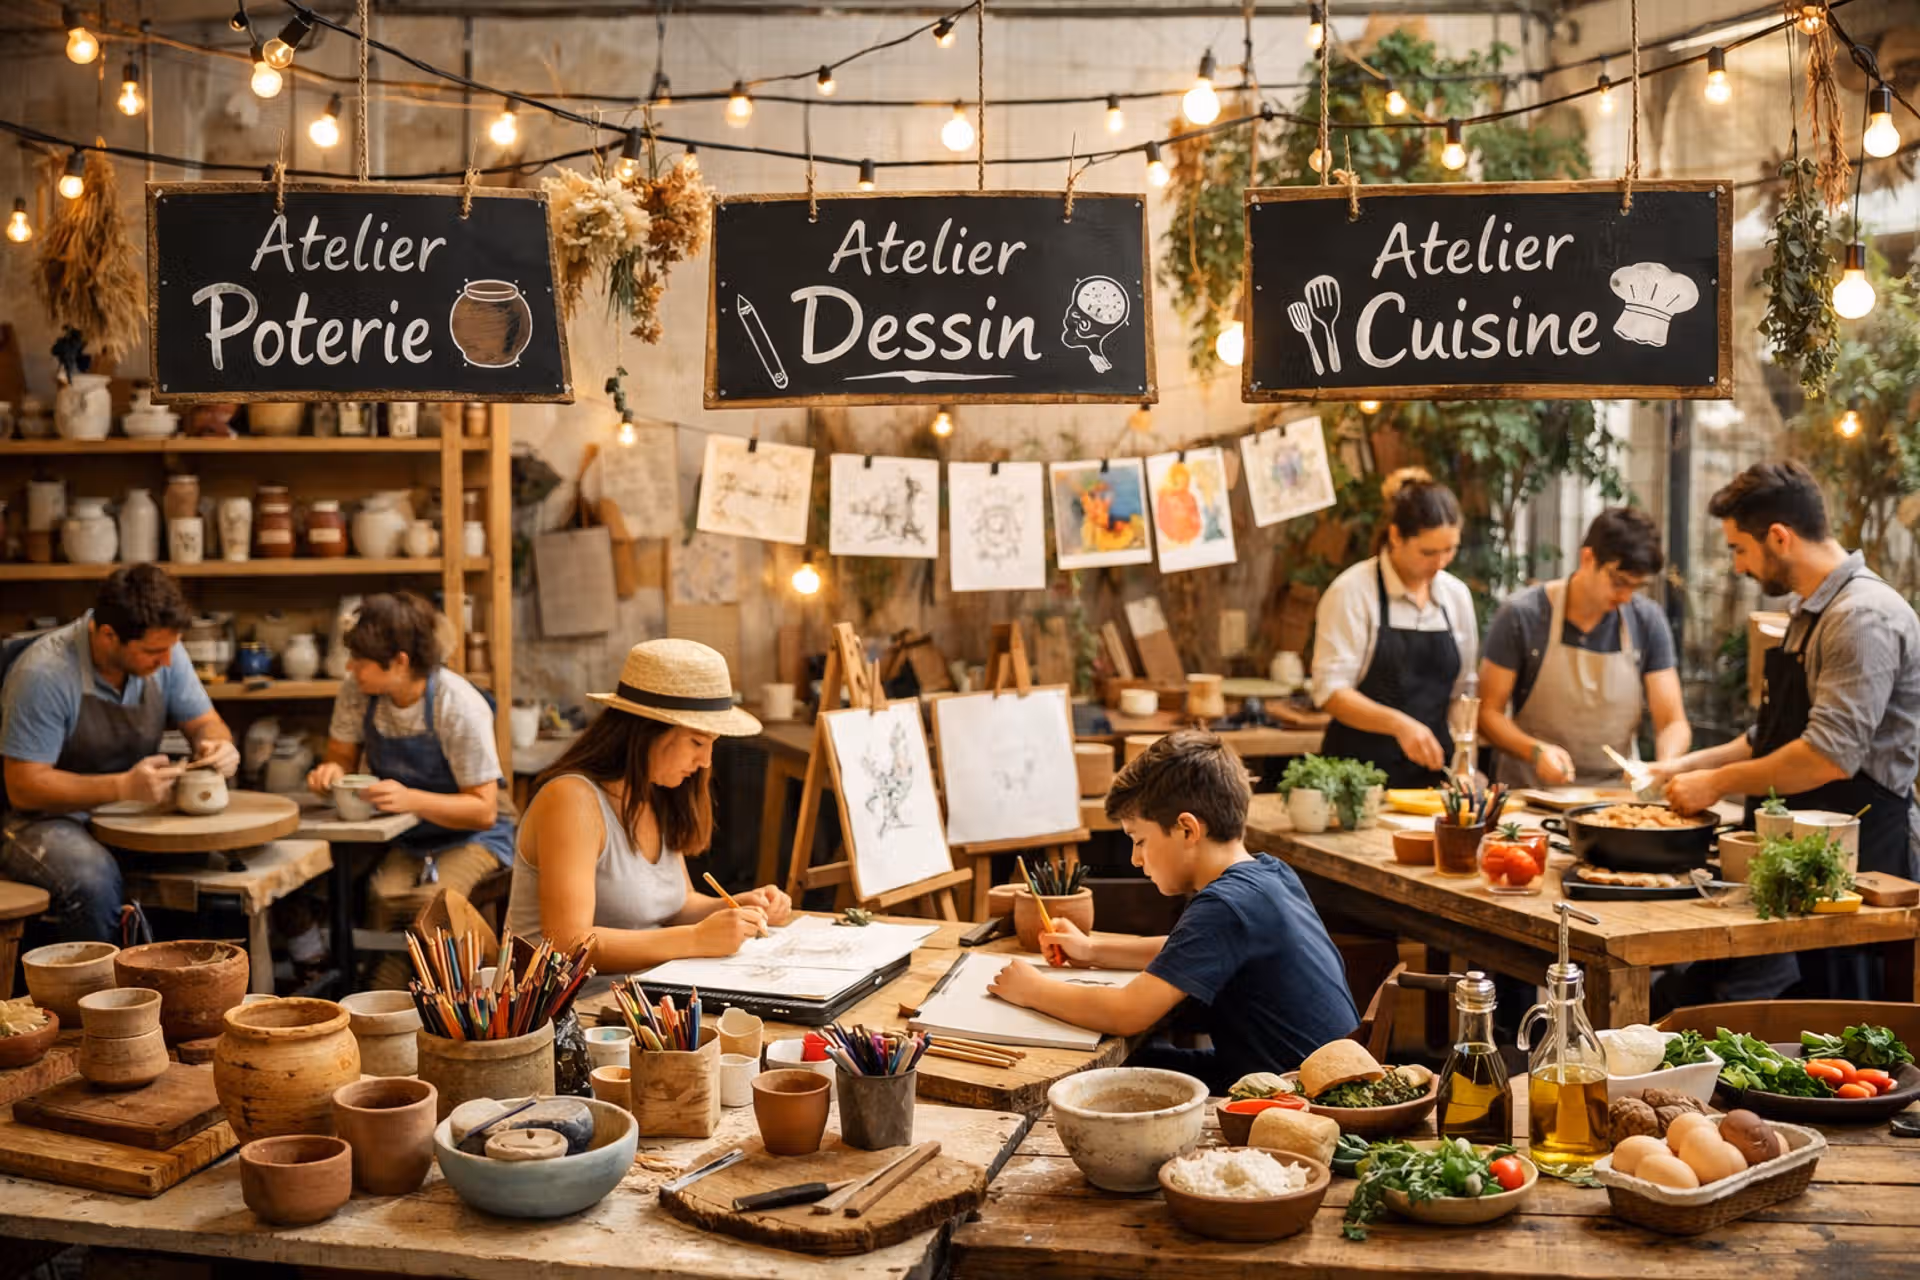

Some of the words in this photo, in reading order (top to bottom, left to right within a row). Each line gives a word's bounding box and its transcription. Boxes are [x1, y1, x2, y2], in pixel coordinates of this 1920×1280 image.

[250, 213, 447, 273] Atelier
[829, 218, 1027, 276] Atelier
[1371, 215, 1575, 279] Atelier
[192, 282, 433, 371] Poterie
[790, 286, 1043, 365] Dessin
[1356, 291, 1601, 369] Cuisine
